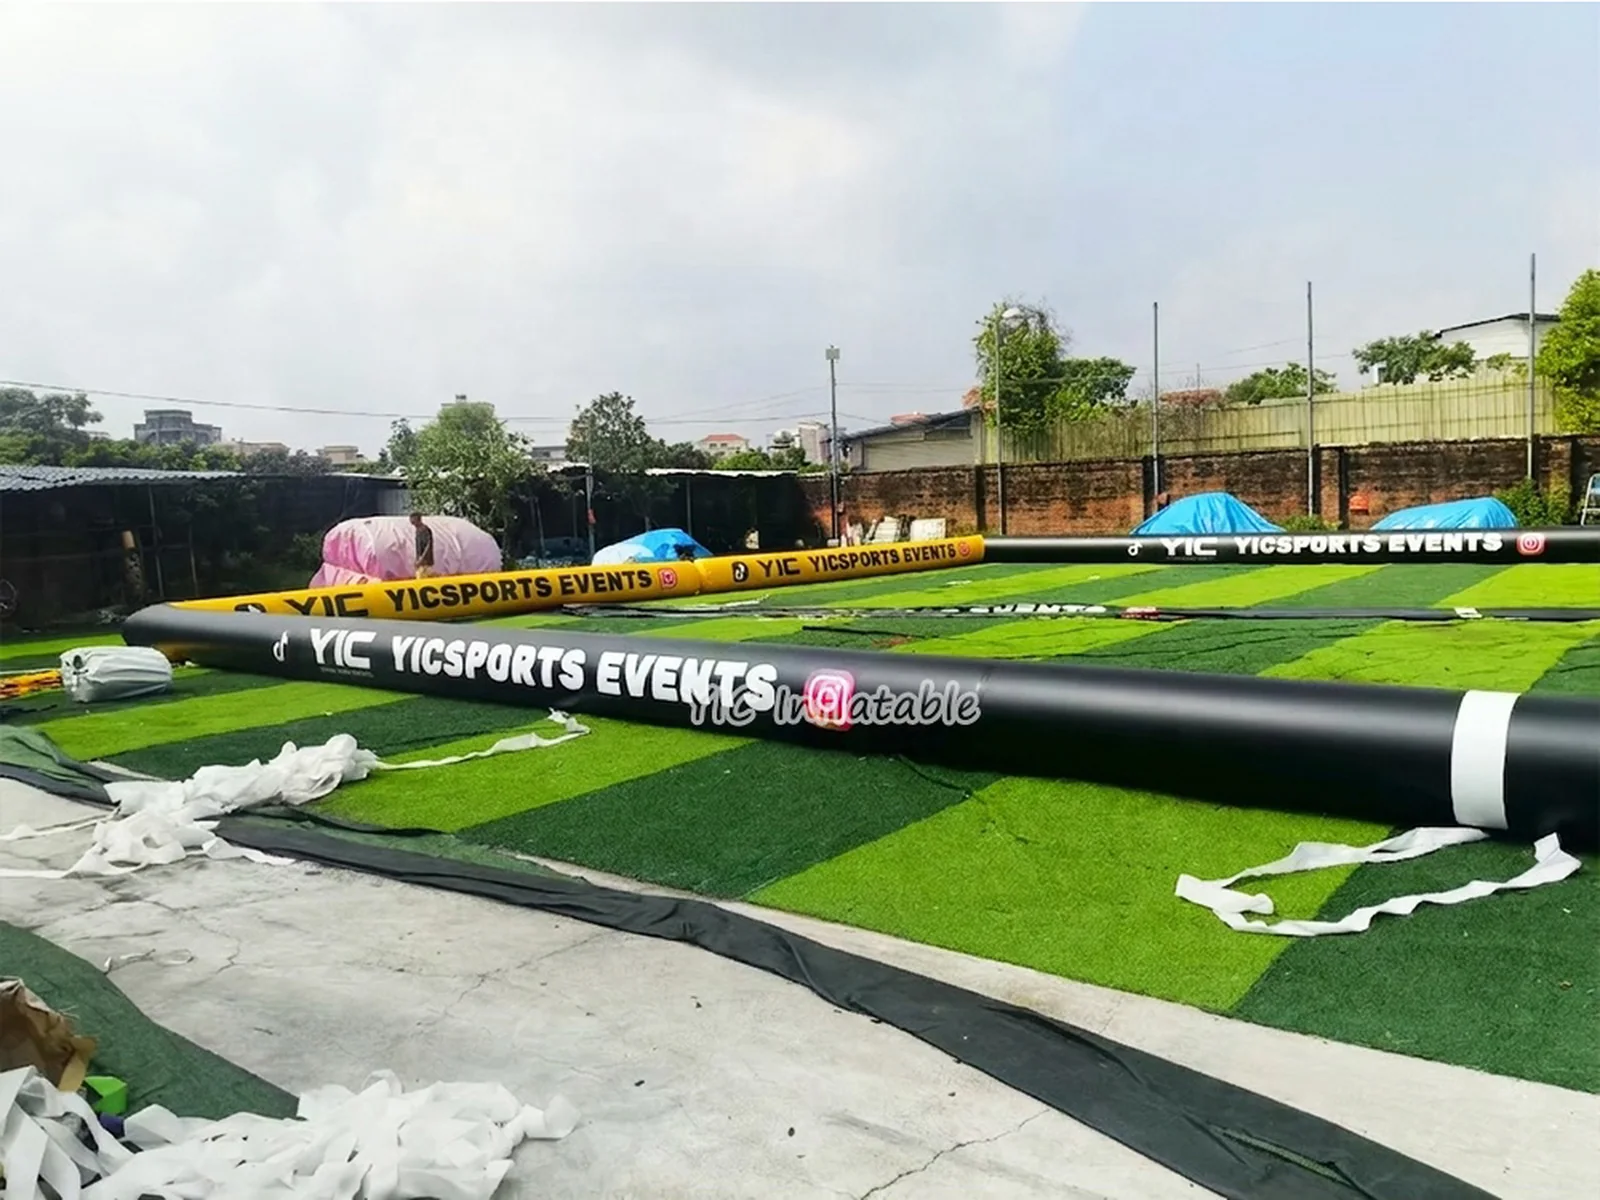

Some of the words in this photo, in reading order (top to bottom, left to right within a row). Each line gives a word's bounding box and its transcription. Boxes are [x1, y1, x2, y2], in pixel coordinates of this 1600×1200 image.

[757, 556, 801, 579] YIC
[807, 548, 900, 573] YICSPORTS
[903, 543, 957, 563] EVENTS
[1160, 537, 1218, 556] YIC
[1234, 534, 1381, 555] YICSPORTS
[1388, 532, 1503, 553] EVENTS
[385, 576, 553, 611] YICSPORTS
[559, 569, 653, 597] EVENTS
[310, 628, 377, 670] YIC
[391, 635, 586, 691] YICSPORTS
[597, 651, 778, 712] EVENTS
